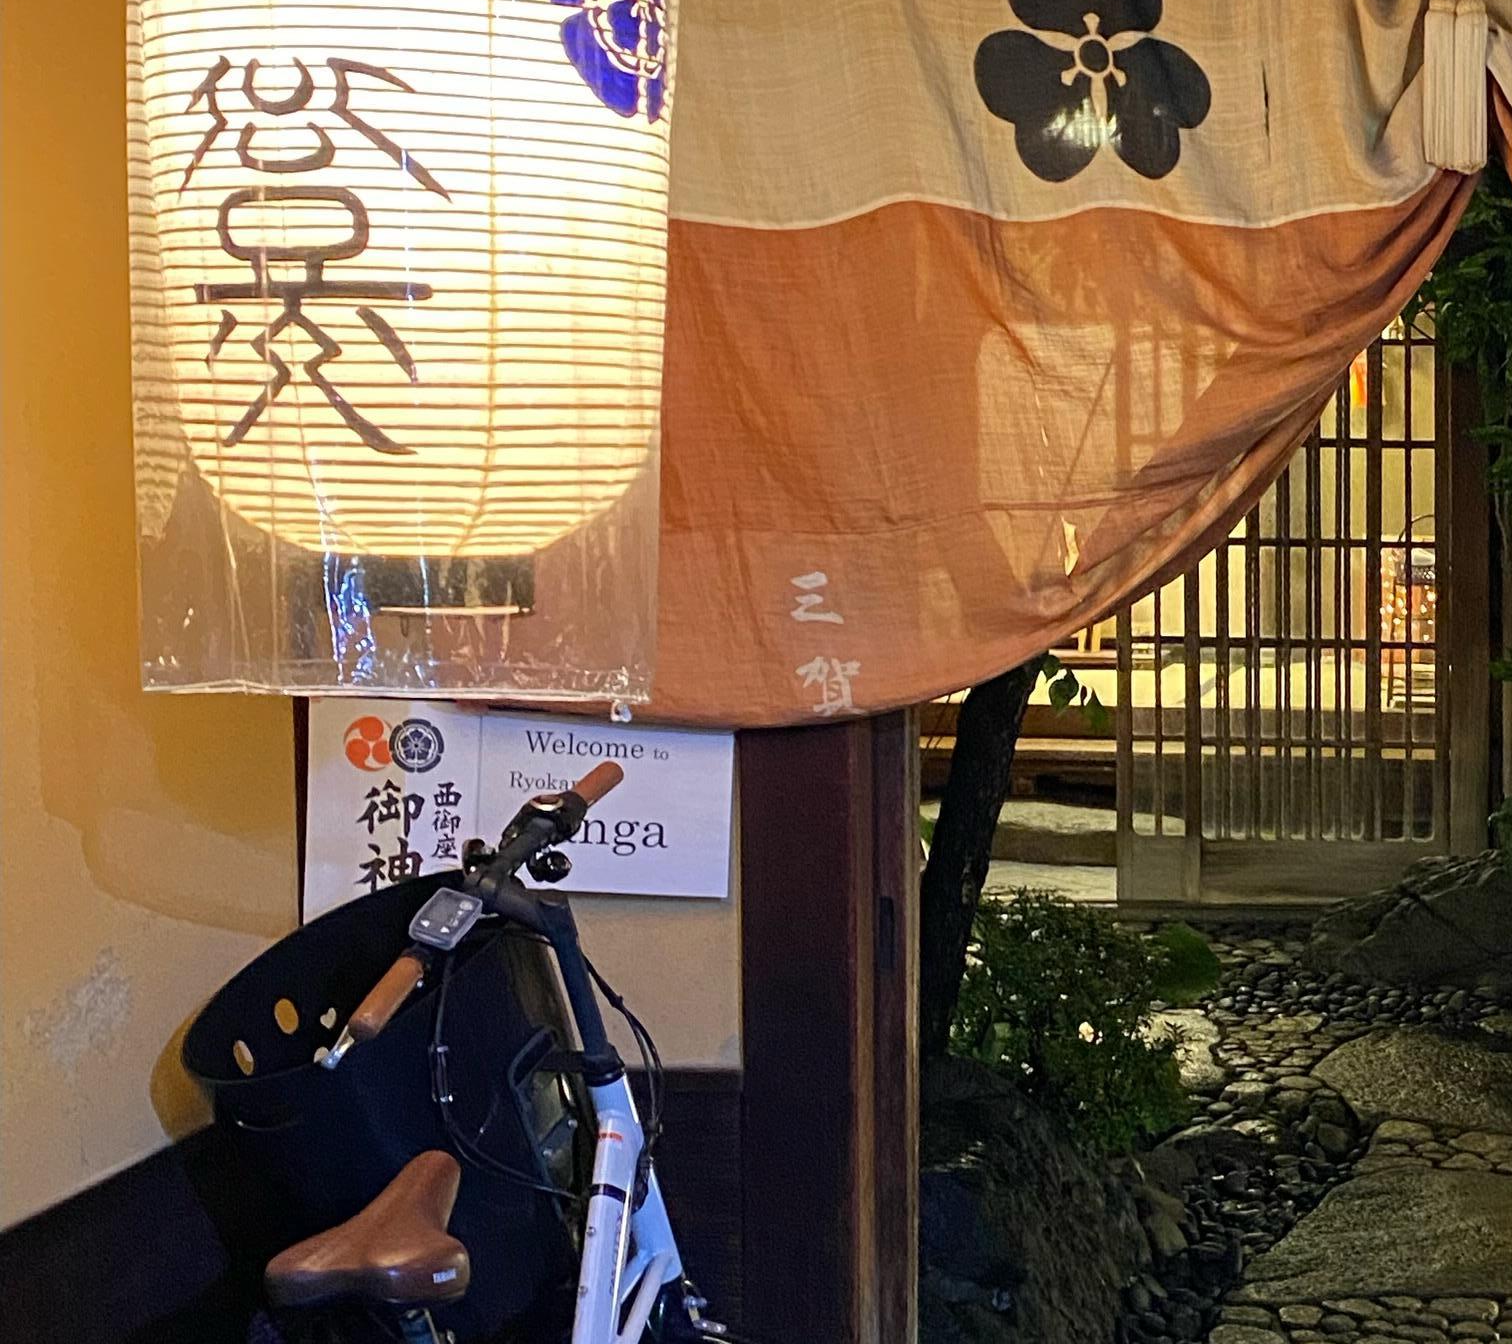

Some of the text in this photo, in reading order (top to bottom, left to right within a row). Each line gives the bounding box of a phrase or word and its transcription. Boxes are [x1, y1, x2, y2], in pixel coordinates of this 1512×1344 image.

[525, 729, 670, 761] Welcome to
[431, 782, 462, 859] 西御座
